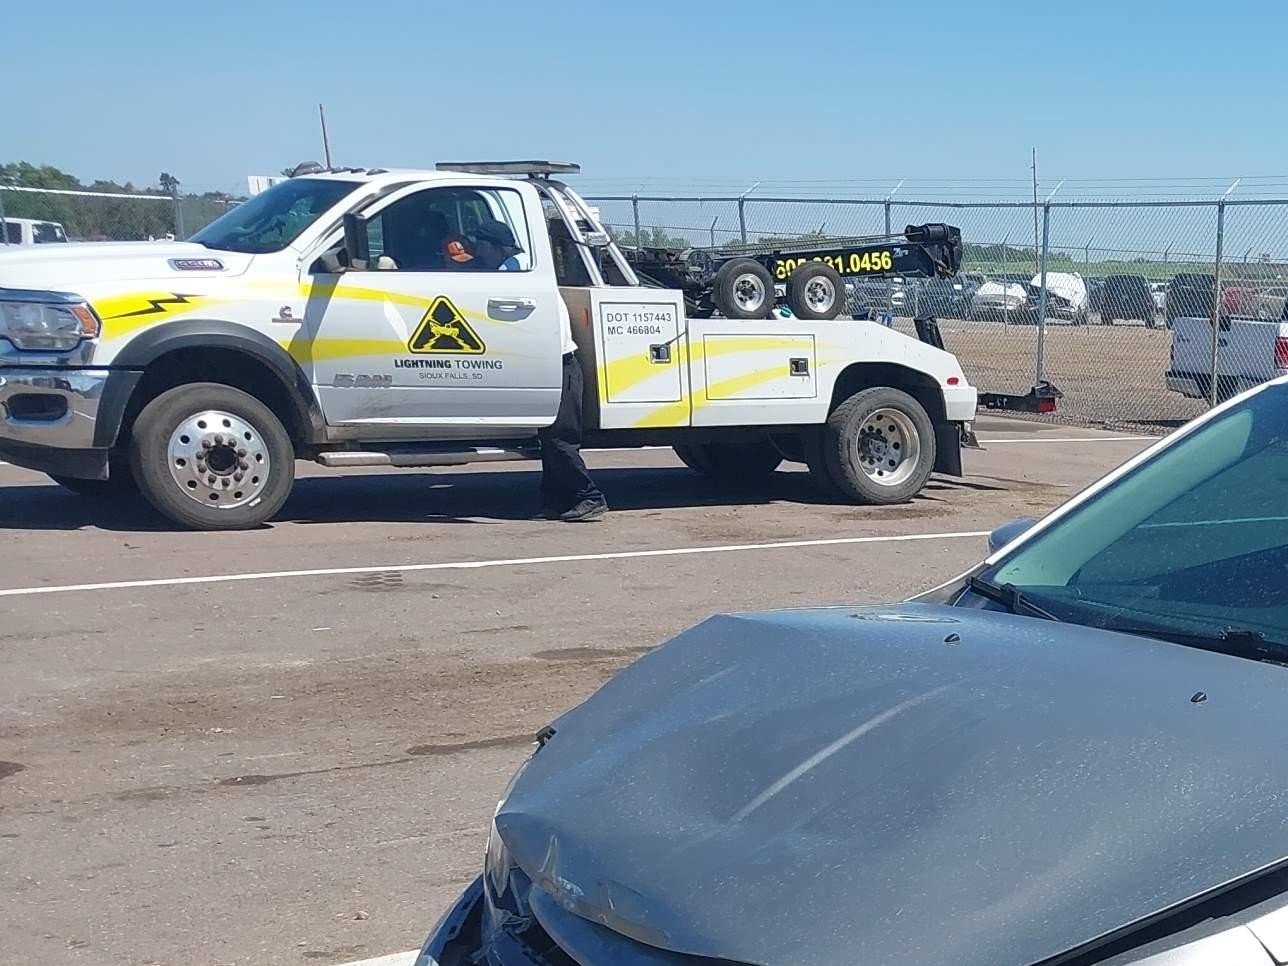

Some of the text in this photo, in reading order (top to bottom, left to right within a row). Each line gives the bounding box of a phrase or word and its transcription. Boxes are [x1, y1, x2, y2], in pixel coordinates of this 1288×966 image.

[607, 313, 672, 322] DOT 1157443
[608, 325, 661, 335] MC 466804
[394, 359, 503, 370] LIGHTNING TOWING
[419, 372, 443, 380] SIOUX
